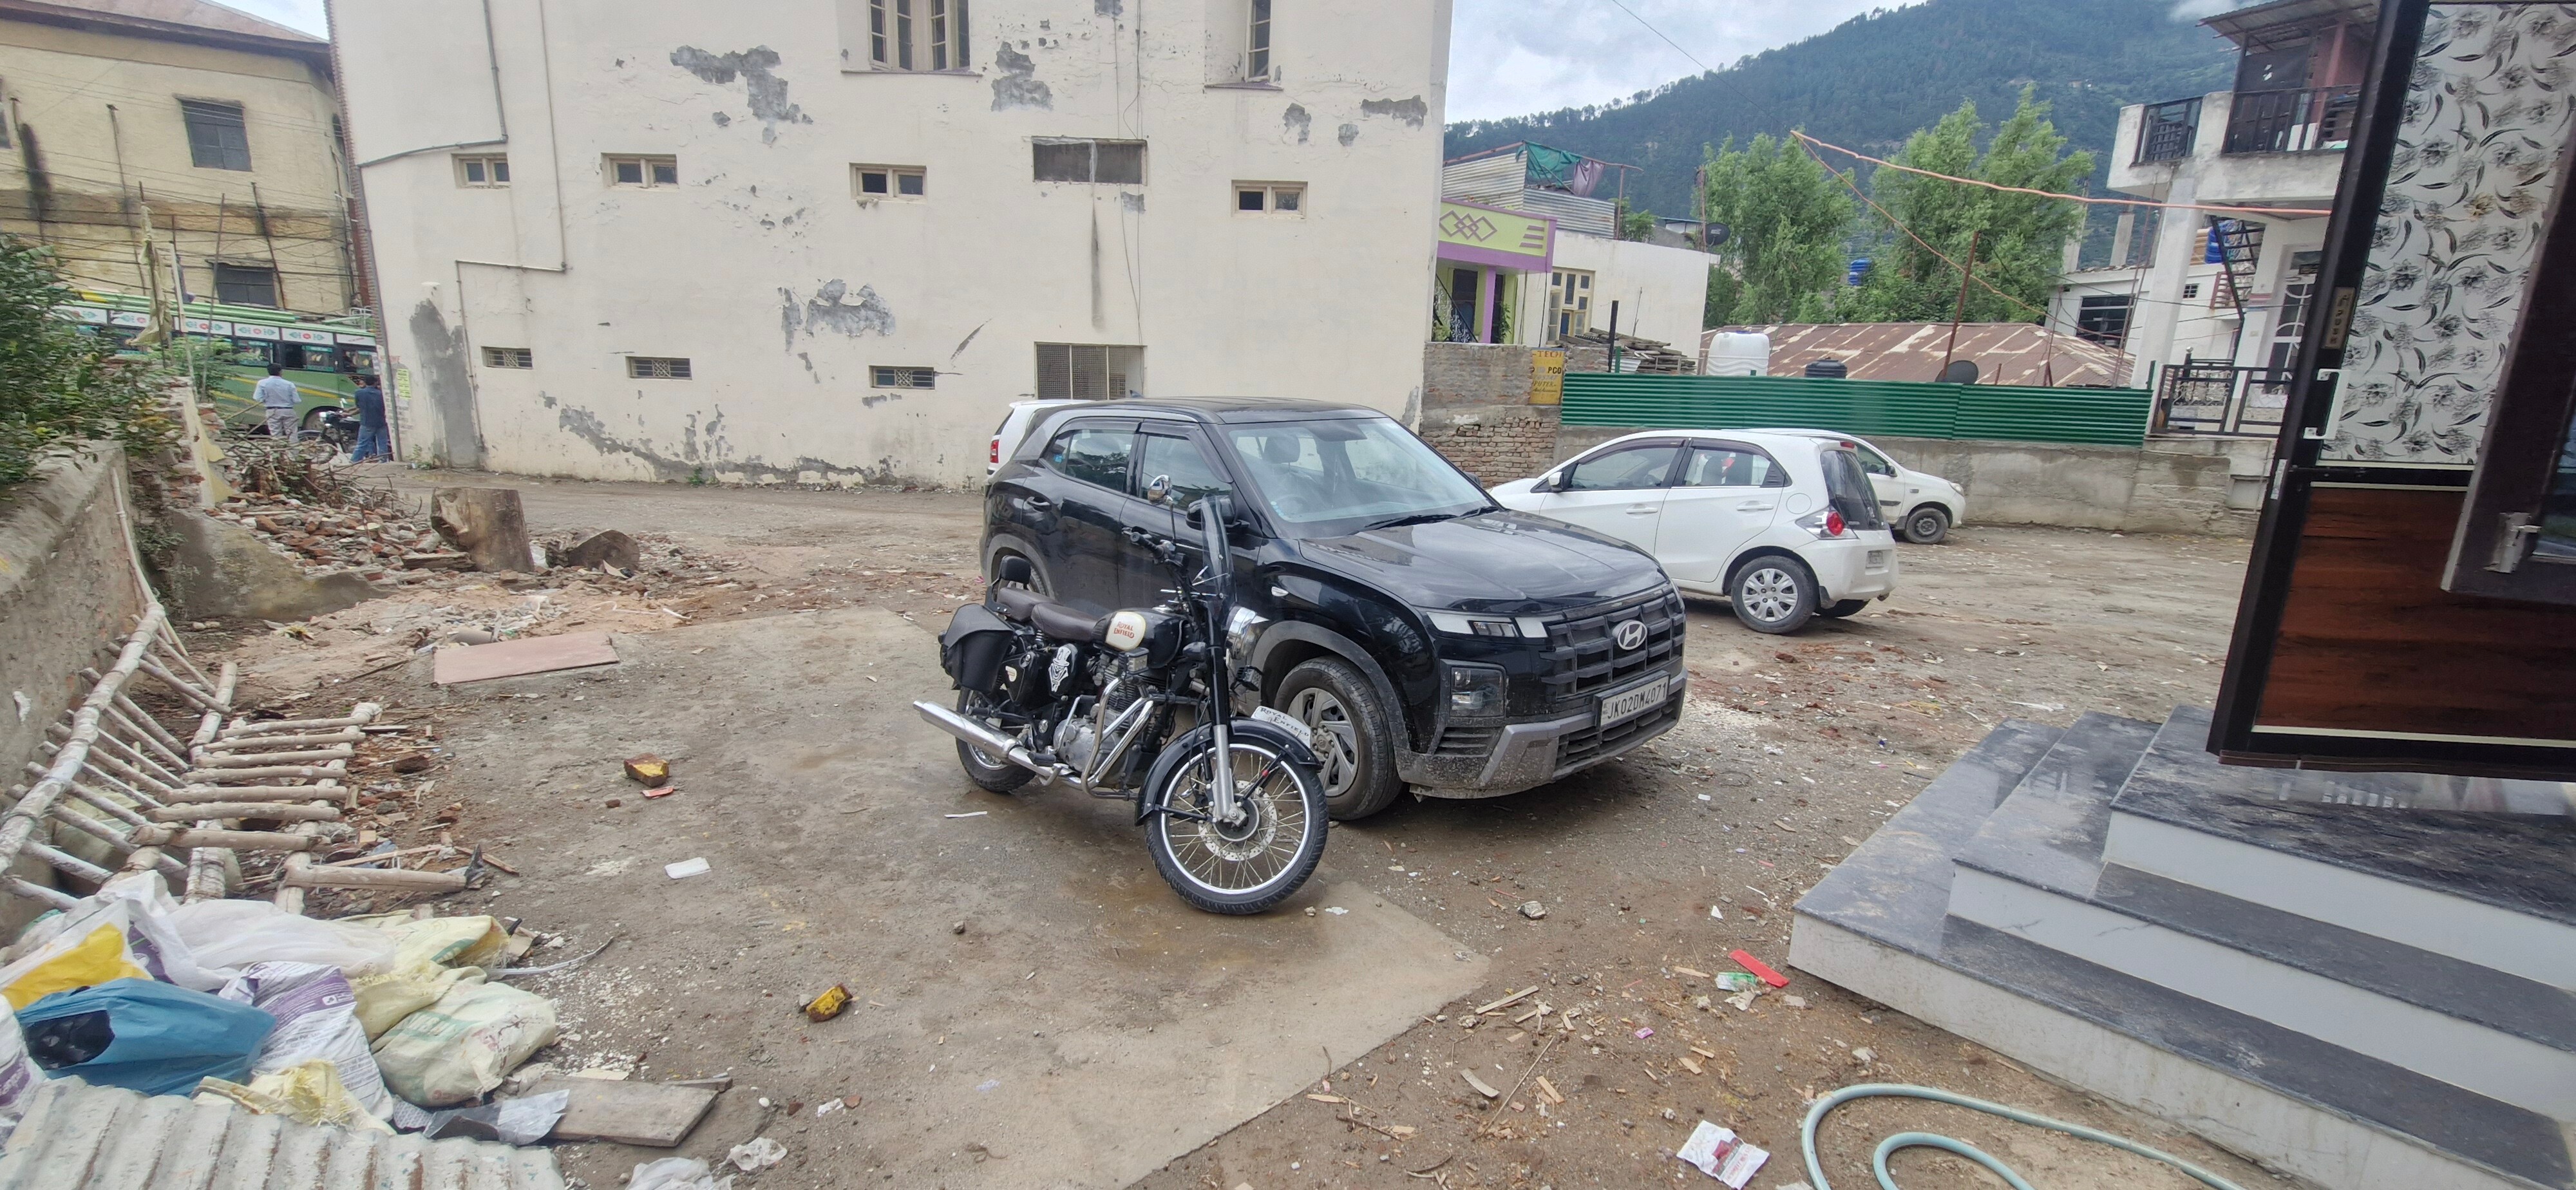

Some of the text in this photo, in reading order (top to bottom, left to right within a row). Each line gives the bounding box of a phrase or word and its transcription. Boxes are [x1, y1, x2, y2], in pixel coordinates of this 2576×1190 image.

[1117, 621, 1133, 631] ROYAL
[1113, 628, 1135, 639] ENFIELD
[1607, 682, 1667, 719] JK02DM4071
[1260, 708, 1287, 721] ROYAL
[1274, 716, 1309, 737] ENFIELD
